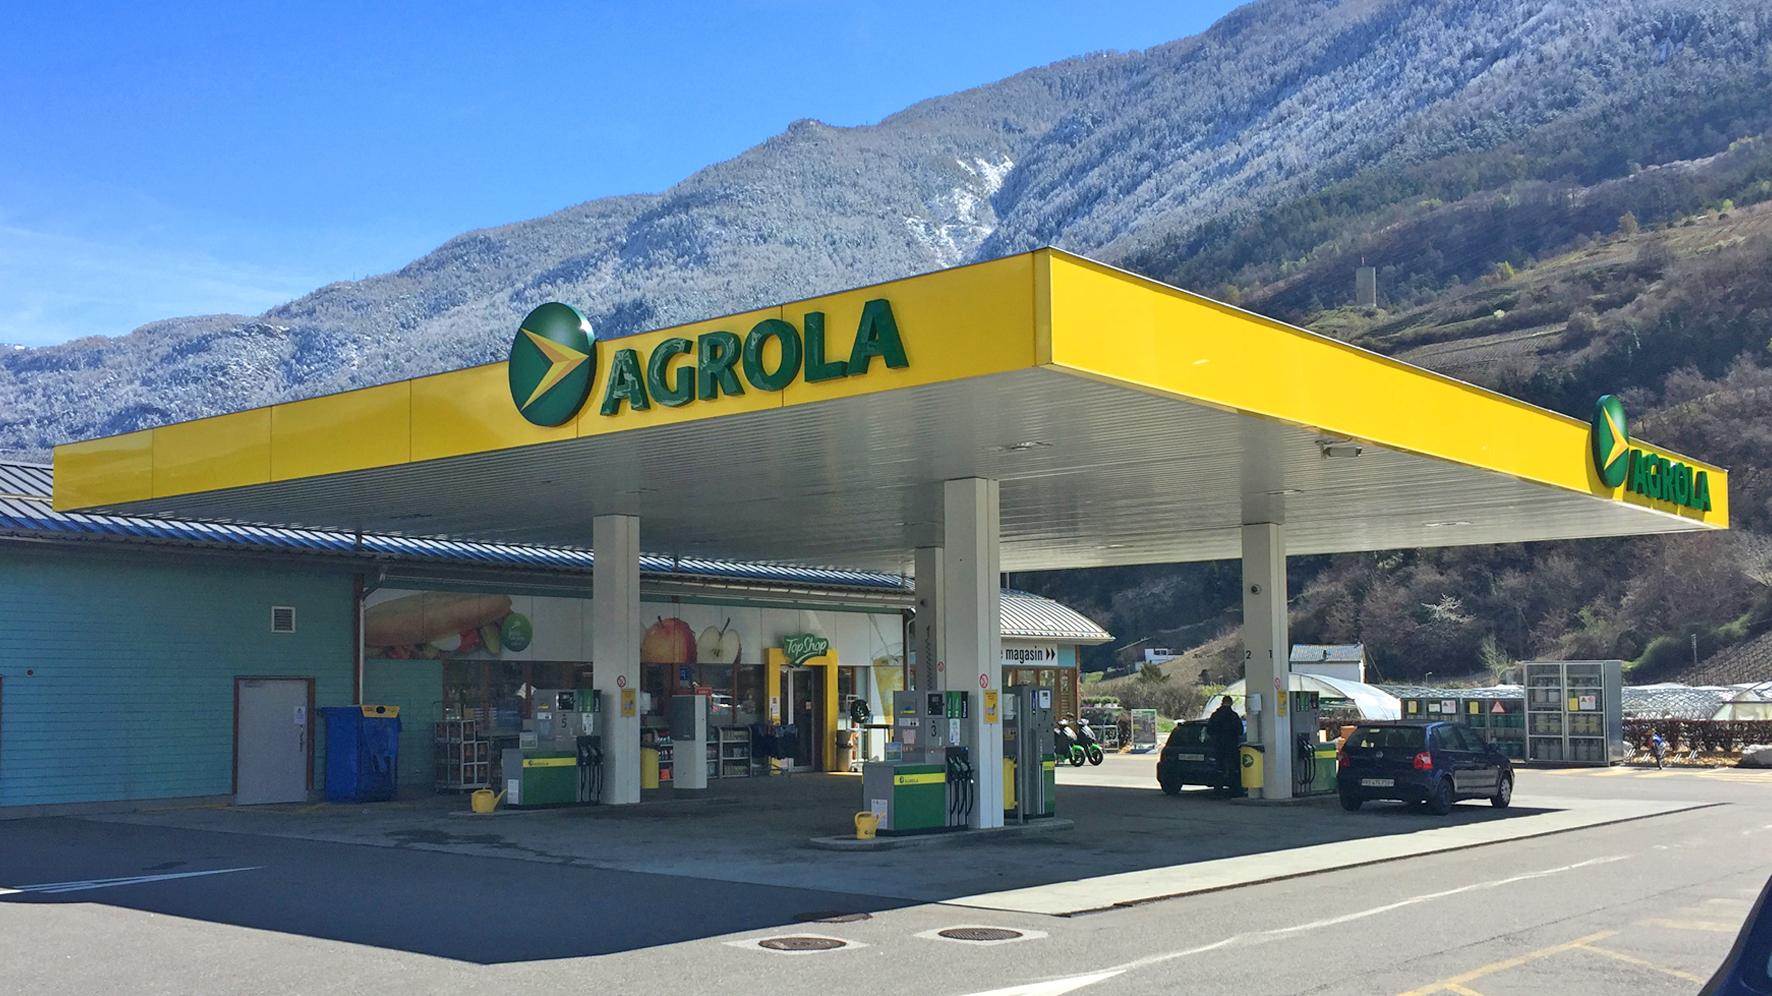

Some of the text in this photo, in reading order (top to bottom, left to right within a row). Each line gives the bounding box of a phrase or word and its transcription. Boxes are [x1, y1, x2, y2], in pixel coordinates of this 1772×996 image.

[600, 299, 909, 416] AGROLA
[1626, 449, 1712, 512] AGROLA
[1006, 645, 1043, 664] magasin
[1245, 650, 1251, 660] 2
[561, 717, 567, 728] 5
[931, 724, 937, 737] 3
